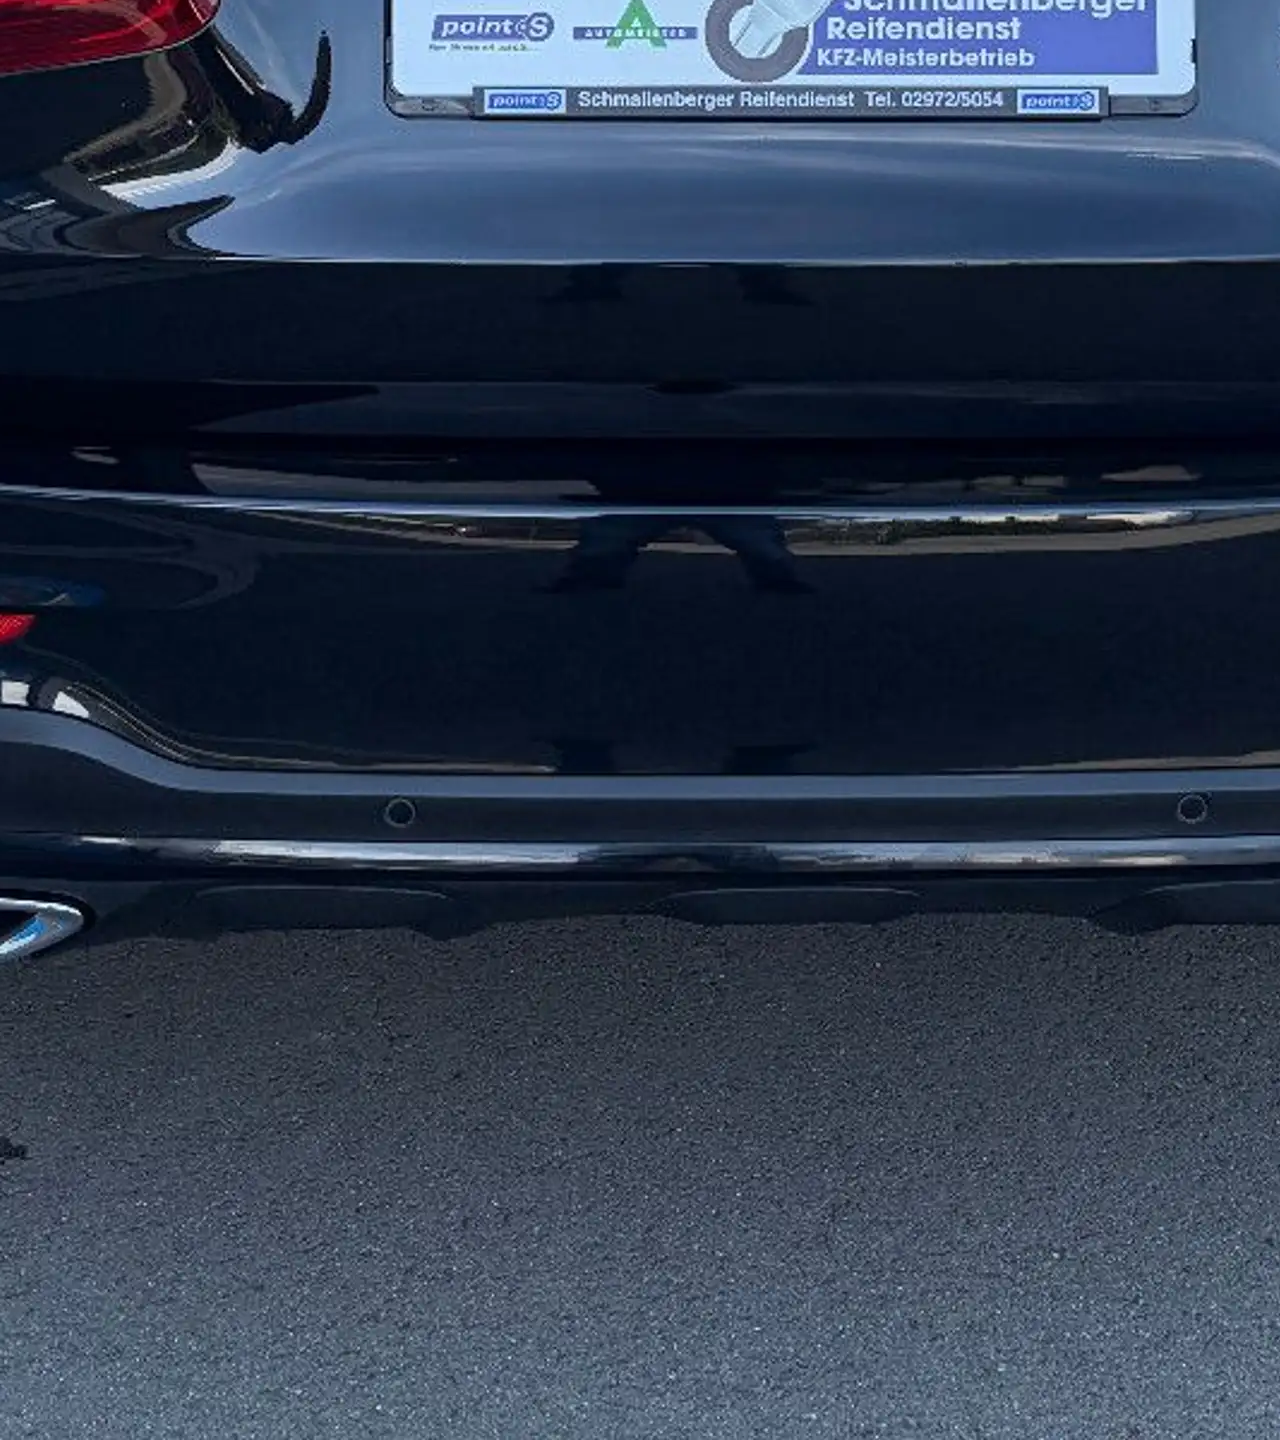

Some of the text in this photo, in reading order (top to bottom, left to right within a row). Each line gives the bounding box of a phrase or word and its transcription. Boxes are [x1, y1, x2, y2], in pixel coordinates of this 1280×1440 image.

[826, 16, 1022, 41] Reifendienst
[816, 47, 1035, 67] KFZ-Meisterbetrieb
[577, 90, 734, 111] Schmallenberger
[740, 90, 855, 108] Reifendienst
[864, 90, 896, 108] Tel.
[901, 90, 1004, 108] 02972/5054
